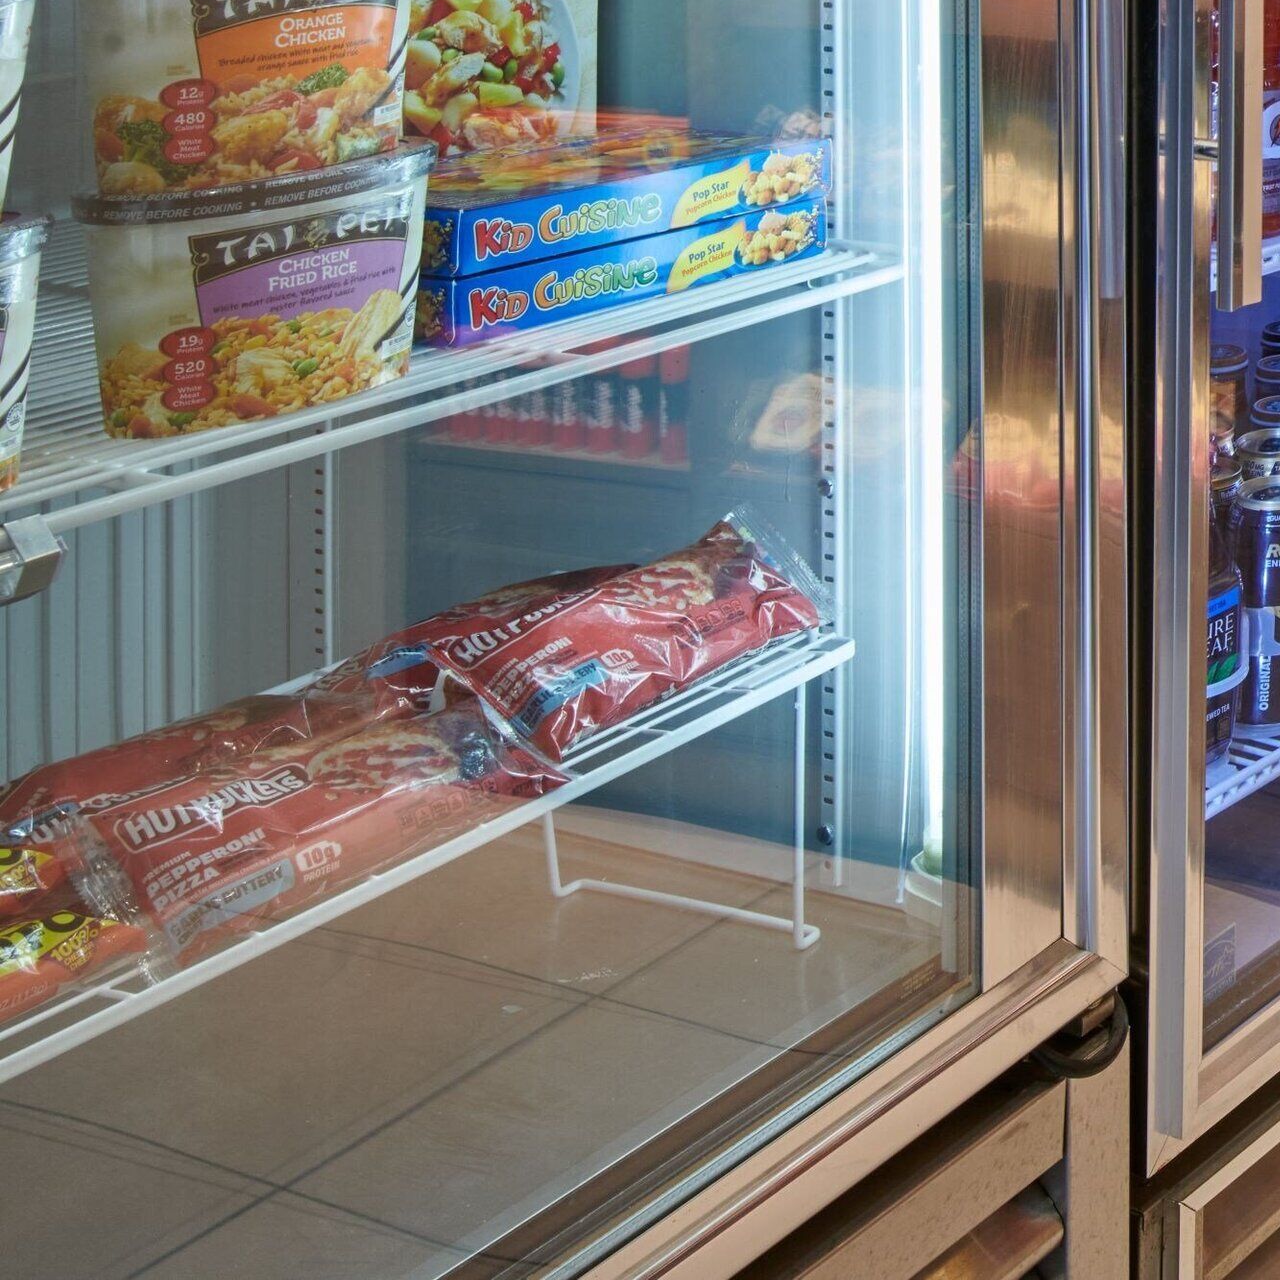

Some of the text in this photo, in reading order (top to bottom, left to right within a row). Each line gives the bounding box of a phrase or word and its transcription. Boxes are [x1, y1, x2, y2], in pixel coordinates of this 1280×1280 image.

[279, 12, 343, 33] ORANGE
[274, 27, 346, 48] CHICKEN
[174, 113, 205, 125] 480
[692, 179, 729, 201] Pop Star
[146, 202, 242, 219] BEFORE COOKING
[279, 249, 350, 273] CHICKEN
[688, 240, 725, 263] Pop Star
[268, 260, 357, 291] FRIED RICE
[175, 360, 205, 373] 520
[1259, 653, 1271, 712] ORIGINAL
[147, 828, 266, 898] PEPPERONI
[153, 867, 220, 913] PIZZA
